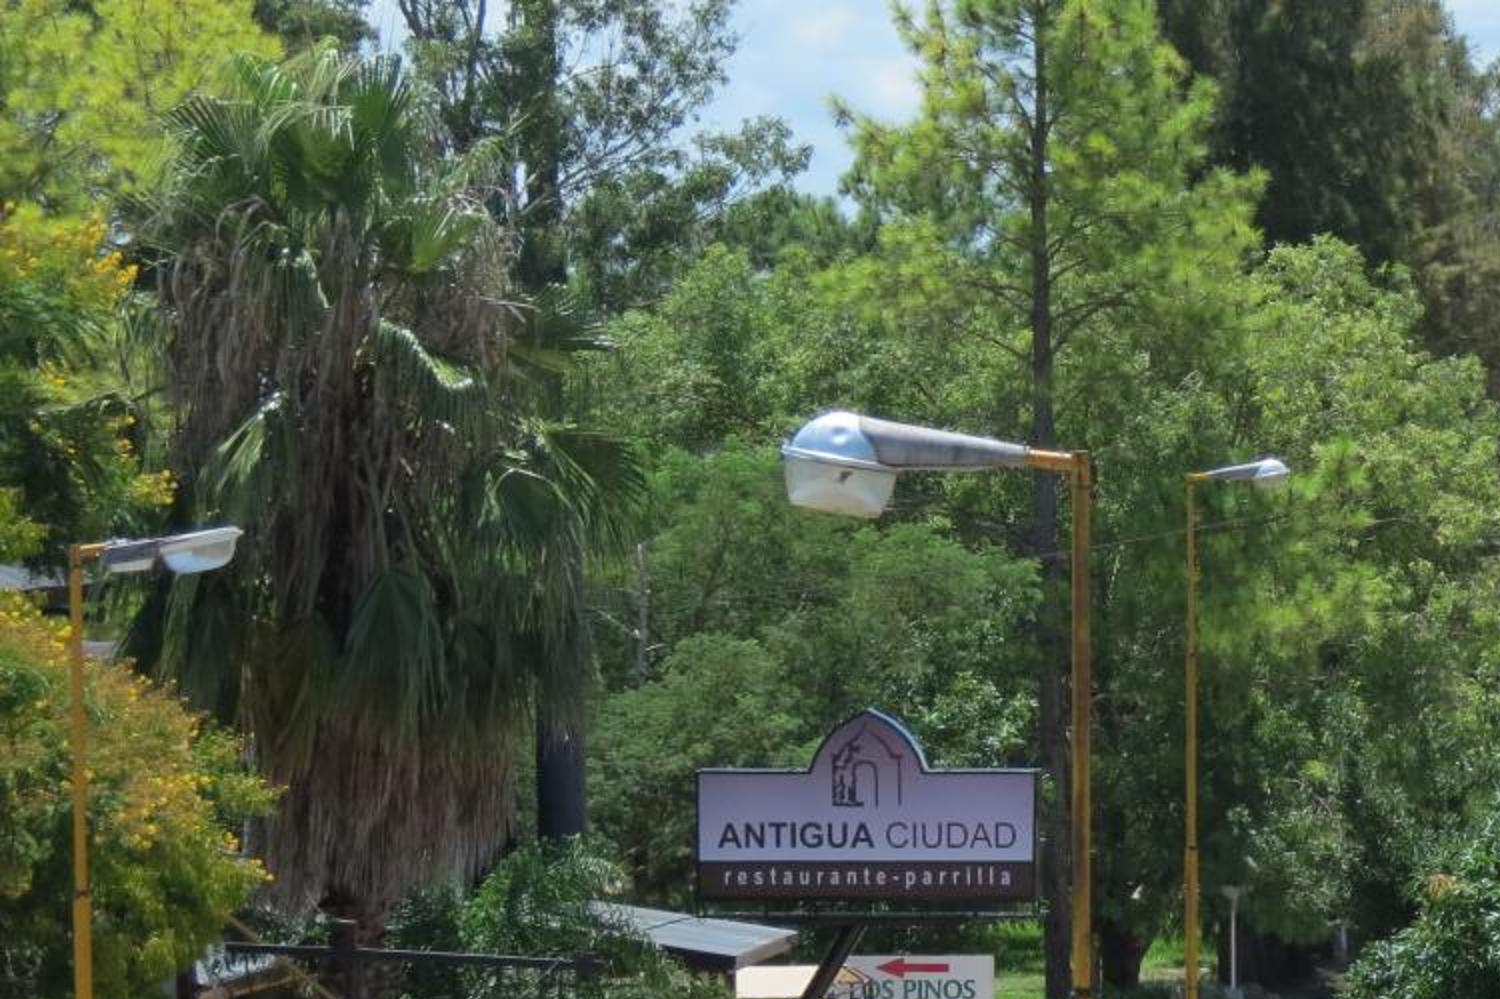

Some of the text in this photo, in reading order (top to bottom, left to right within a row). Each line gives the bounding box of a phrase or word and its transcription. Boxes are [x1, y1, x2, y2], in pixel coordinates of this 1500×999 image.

[718, 821, 1017, 849] ANTIGUA CIUDAD
[724, 867, 1012, 889] restaurante-parrilla
